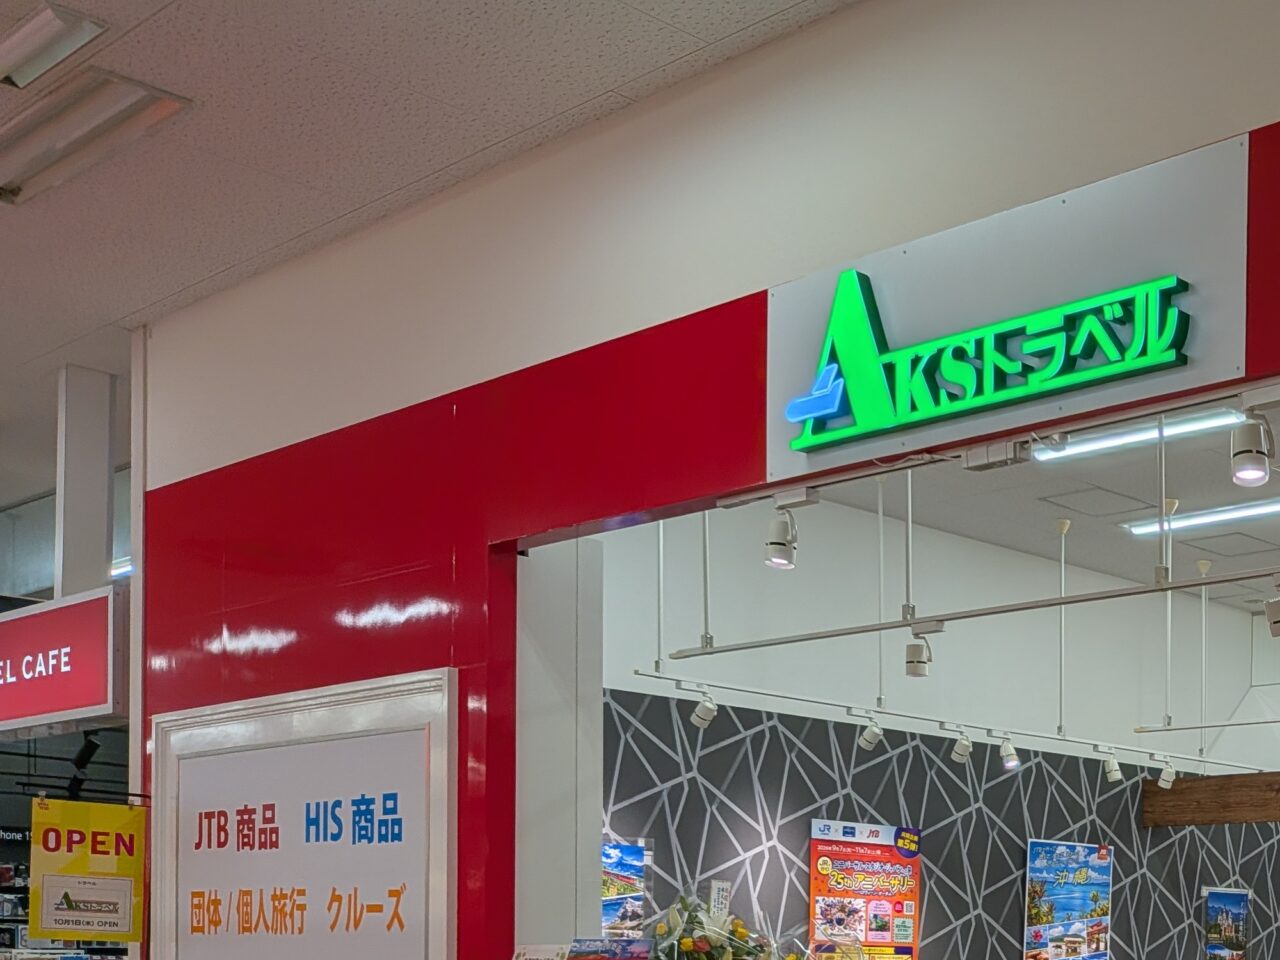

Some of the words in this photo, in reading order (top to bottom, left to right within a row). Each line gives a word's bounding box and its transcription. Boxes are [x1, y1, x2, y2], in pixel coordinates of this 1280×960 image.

[790, 269, 1184, 451] AKSトラベル
[22, 646, 71, 680] CAFE
[42, 827, 135, 857] OPEN
[194, 809, 229, 851] JTB
[235, 803, 280, 852] 商品
[305, 799, 344, 843] HIS
[351, 792, 403, 845] 商品
[97, 920, 119, 928] OPEN
[327, 882, 408, 933] クルーズ
